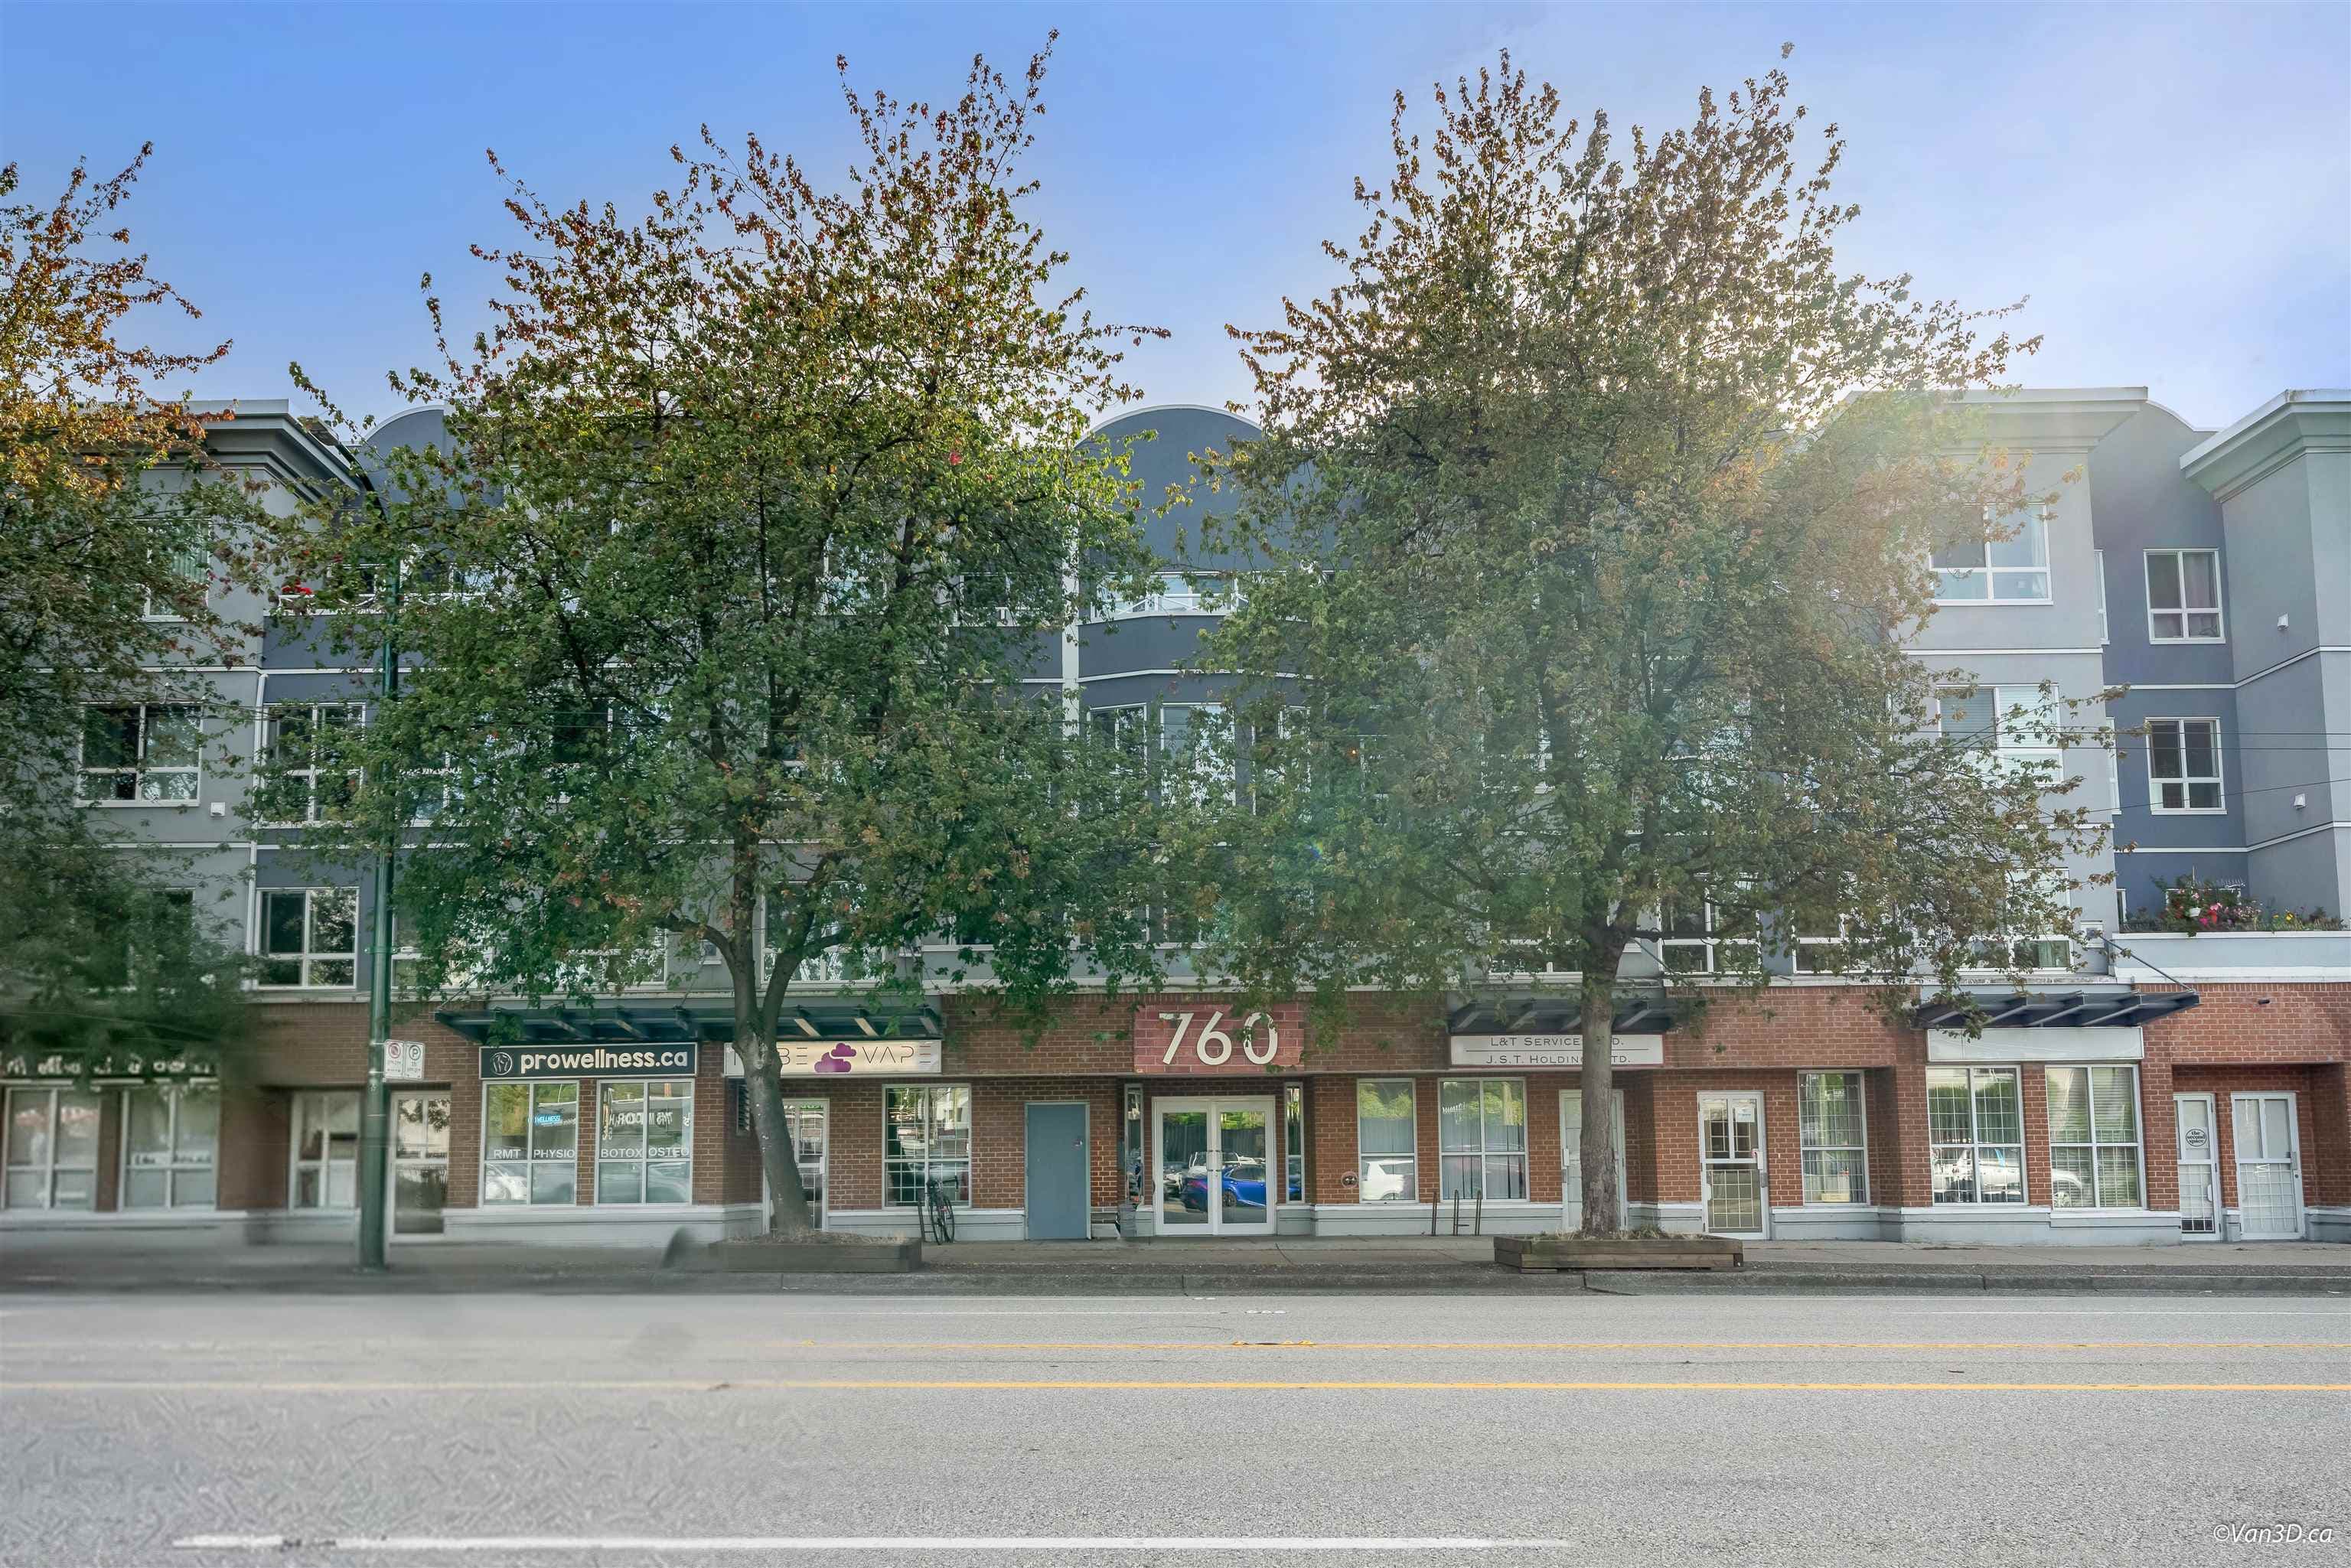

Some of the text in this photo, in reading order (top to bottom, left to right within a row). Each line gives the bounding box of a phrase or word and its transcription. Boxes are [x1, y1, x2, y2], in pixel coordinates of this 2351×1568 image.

[1159, 1010, 1279, 1066] 760
[1490, 1037, 1518, 1047] L&T
[1523, 1037, 1581, 1046] SERVICE
[520, 1048, 688, 1074] prowellness.ca
[861, 1045, 932, 1064] VAPE
[1485, 1055, 1524, 1064] J.S.T.
[1529, 1055, 1583, 1064] HOLDIN
[494, 1146, 690, 1159] RMT PHYSIO BOTOX OSTEO
